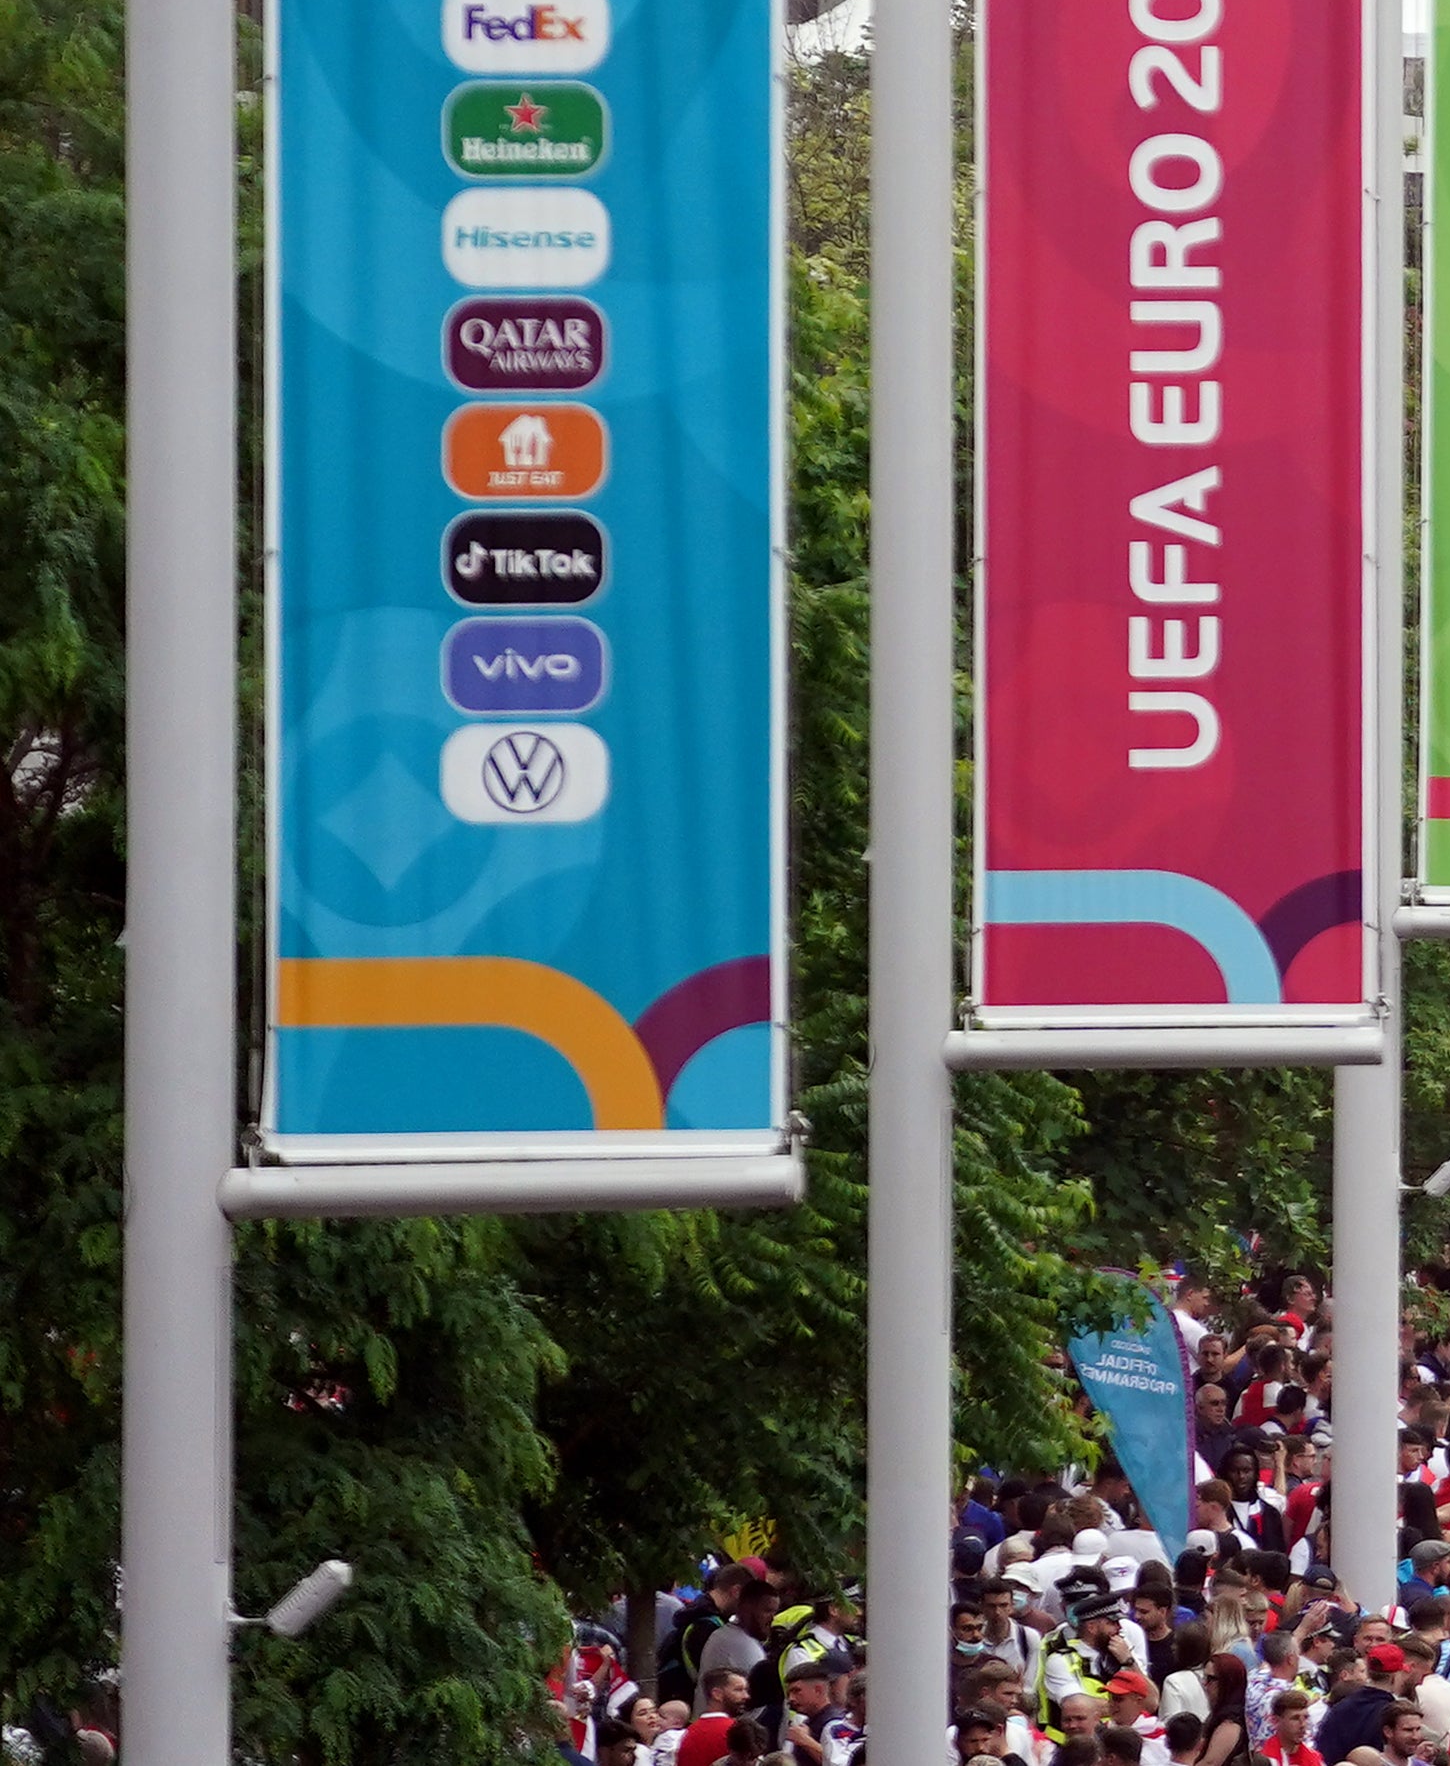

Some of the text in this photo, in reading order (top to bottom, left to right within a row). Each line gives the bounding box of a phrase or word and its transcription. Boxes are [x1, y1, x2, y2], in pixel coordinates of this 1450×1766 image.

[463, 3, 586, 42] FedEx
[461, 137, 592, 162] Heineken
[454, 226, 596, 250] Hisense
[1128, 134, 1223, 446] EURO
[459, 317, 592, 356] QATAR
[488, 348, 594, 374] AIRWAYS
[488, 471, 566, 487] JUST EAT
[489, 547, 597, 576] TikTok
[1128, 465, 1222, 769] UEFA
[472, 647, 582, 683] vivo
